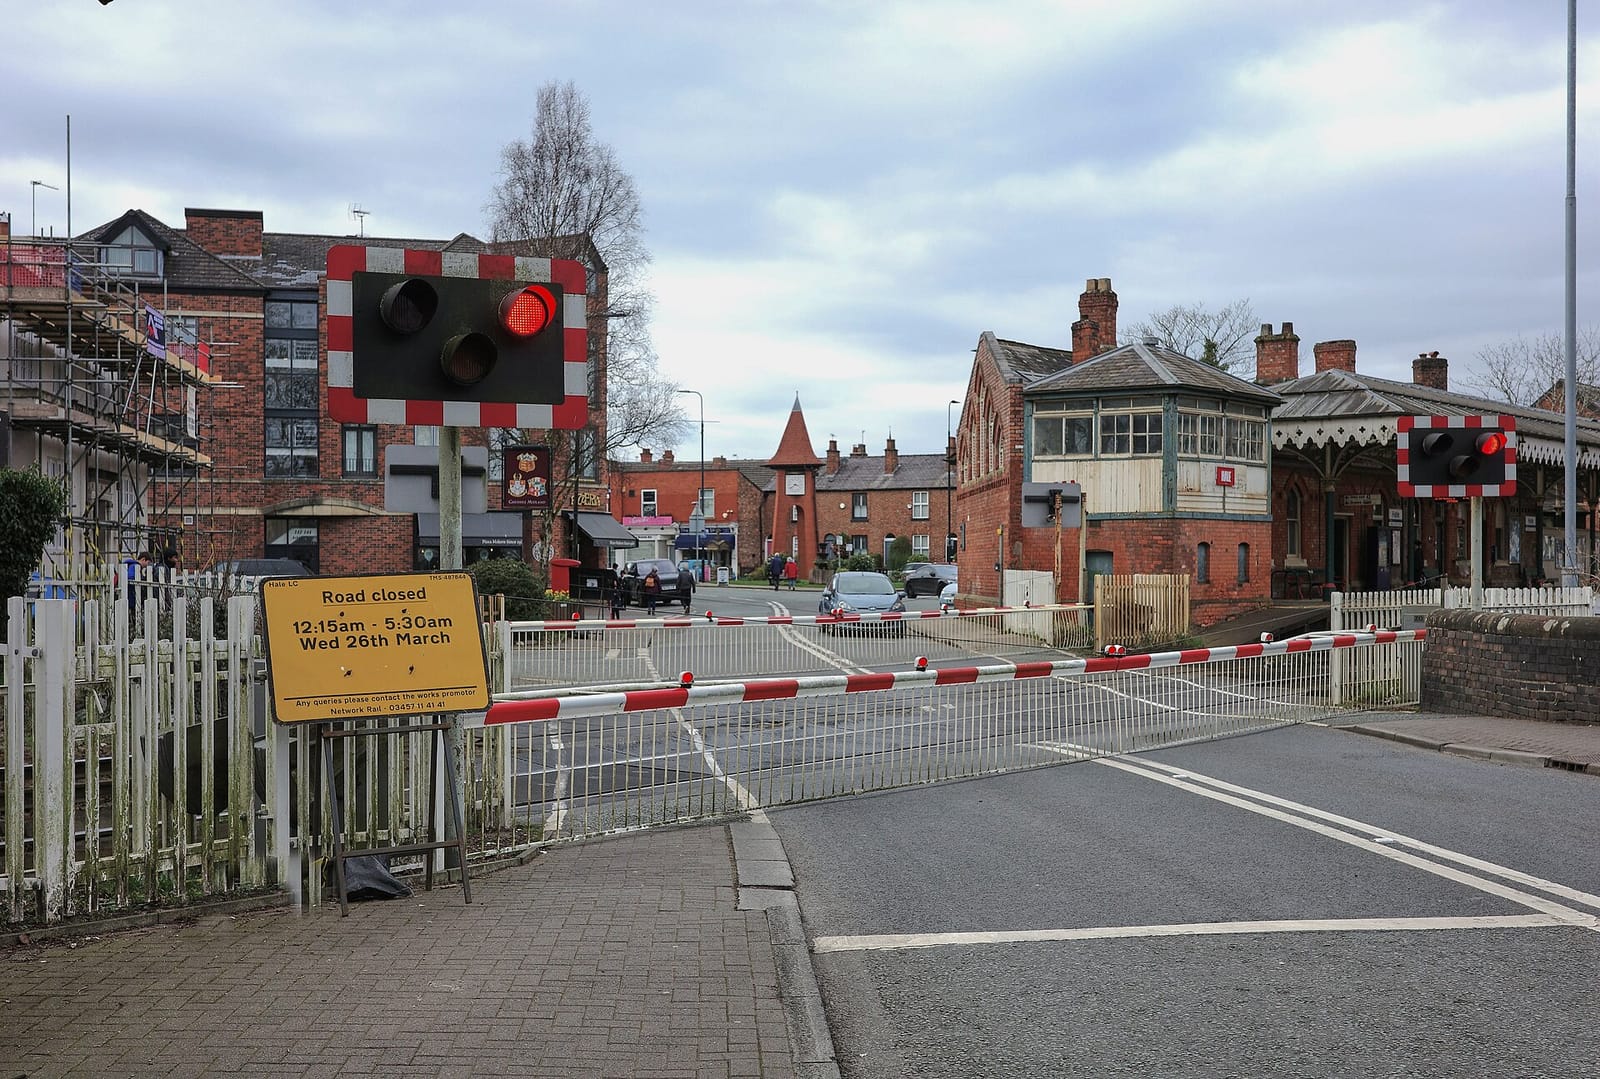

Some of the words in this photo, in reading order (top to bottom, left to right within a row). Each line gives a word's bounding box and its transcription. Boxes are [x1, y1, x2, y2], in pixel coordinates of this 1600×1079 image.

[322, 589, 366, 604] Road
[372, 587, 427, 602] closed
[293, 620, 365, 634] 12:15am
[385, 616, 453, 630] 5:30am
[299, 636, 340, 651] Wed
[346, 634, 389, 649] 26th
[396, 631, 451, 646] March
[313, 698, 342, 706] queries
[344, 695, 369, 704] please
[371, 693, 401, 702] contact
[402, 692, 415, 700] the
[417, 690, 440, 699] works
[442, 689, 476, 698] promotor
[330, 707, 364, 715] Network
[367, 705, 382, 713] Rail
[389, 703, 415, 711] 03457
